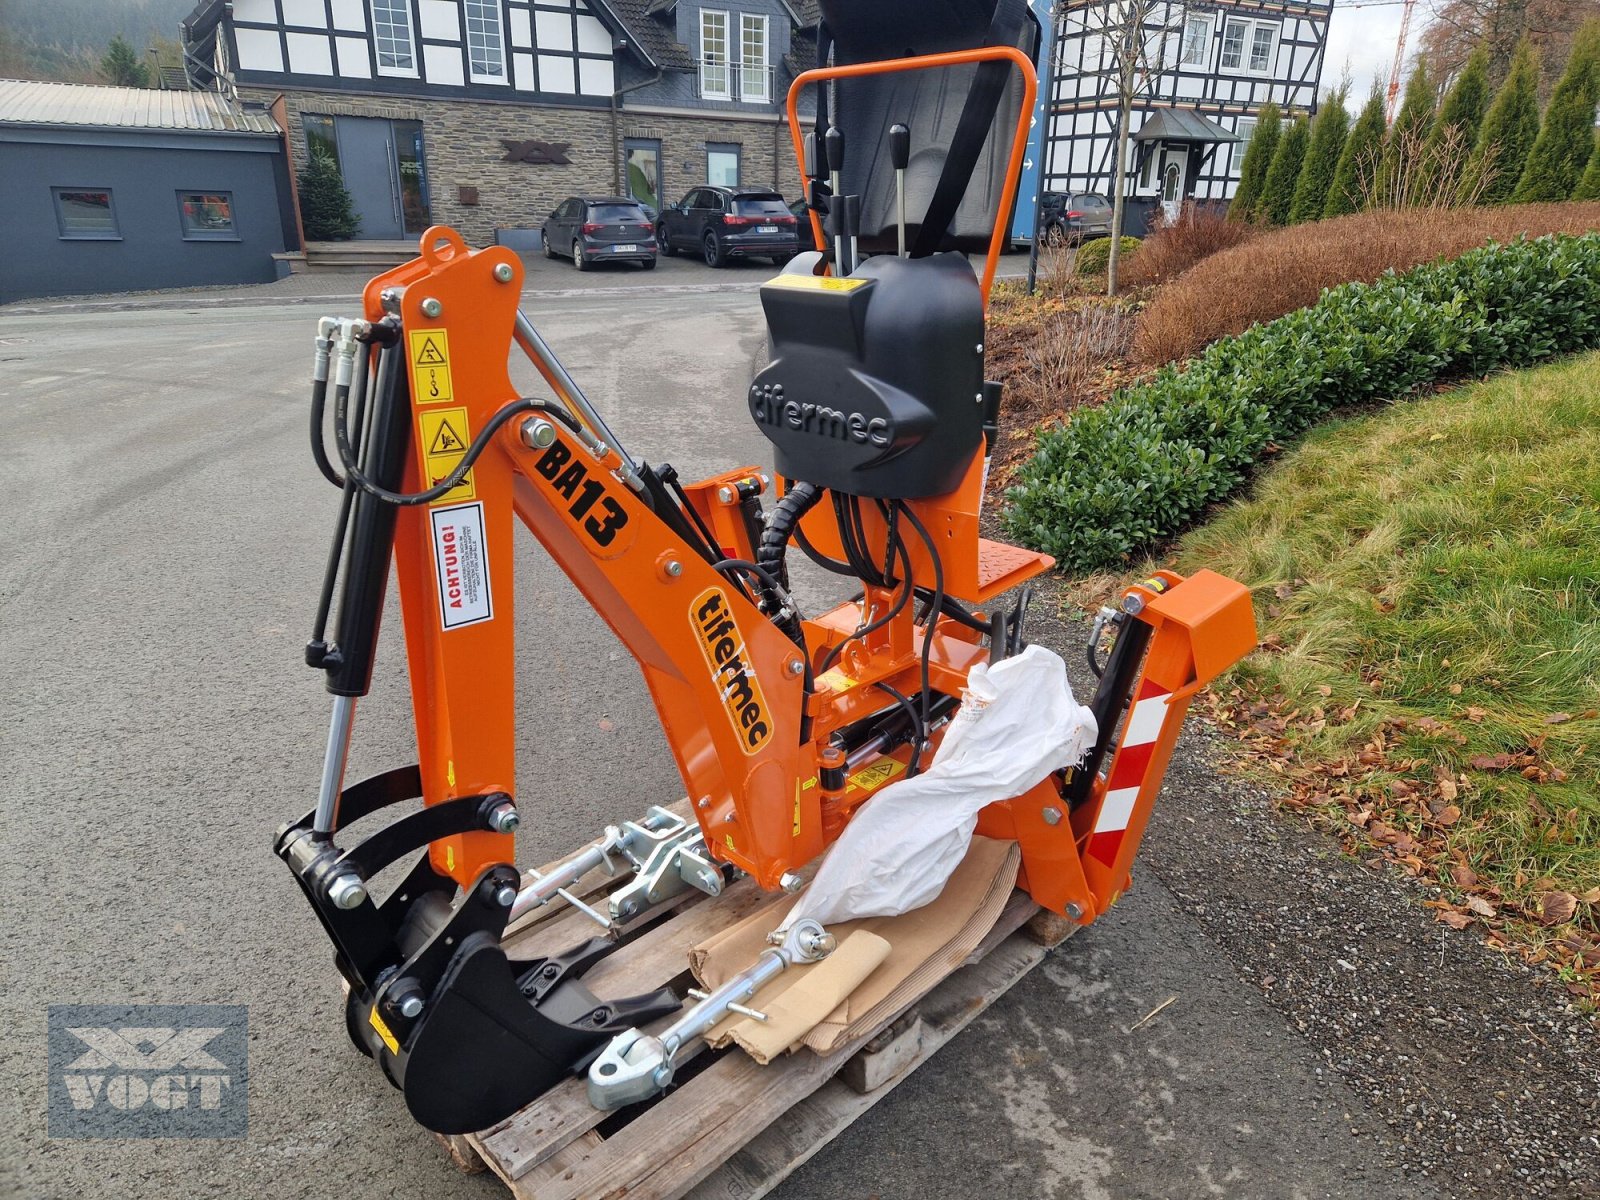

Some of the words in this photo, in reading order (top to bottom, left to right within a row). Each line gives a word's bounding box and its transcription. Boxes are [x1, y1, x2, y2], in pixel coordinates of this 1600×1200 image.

[751, 384, 888, 446] tifermec
[534, 438, 629, 547] BA13
[442, 526, 462, 608] ACHTUNG!
[698, 593, 767, 747] tifermec
